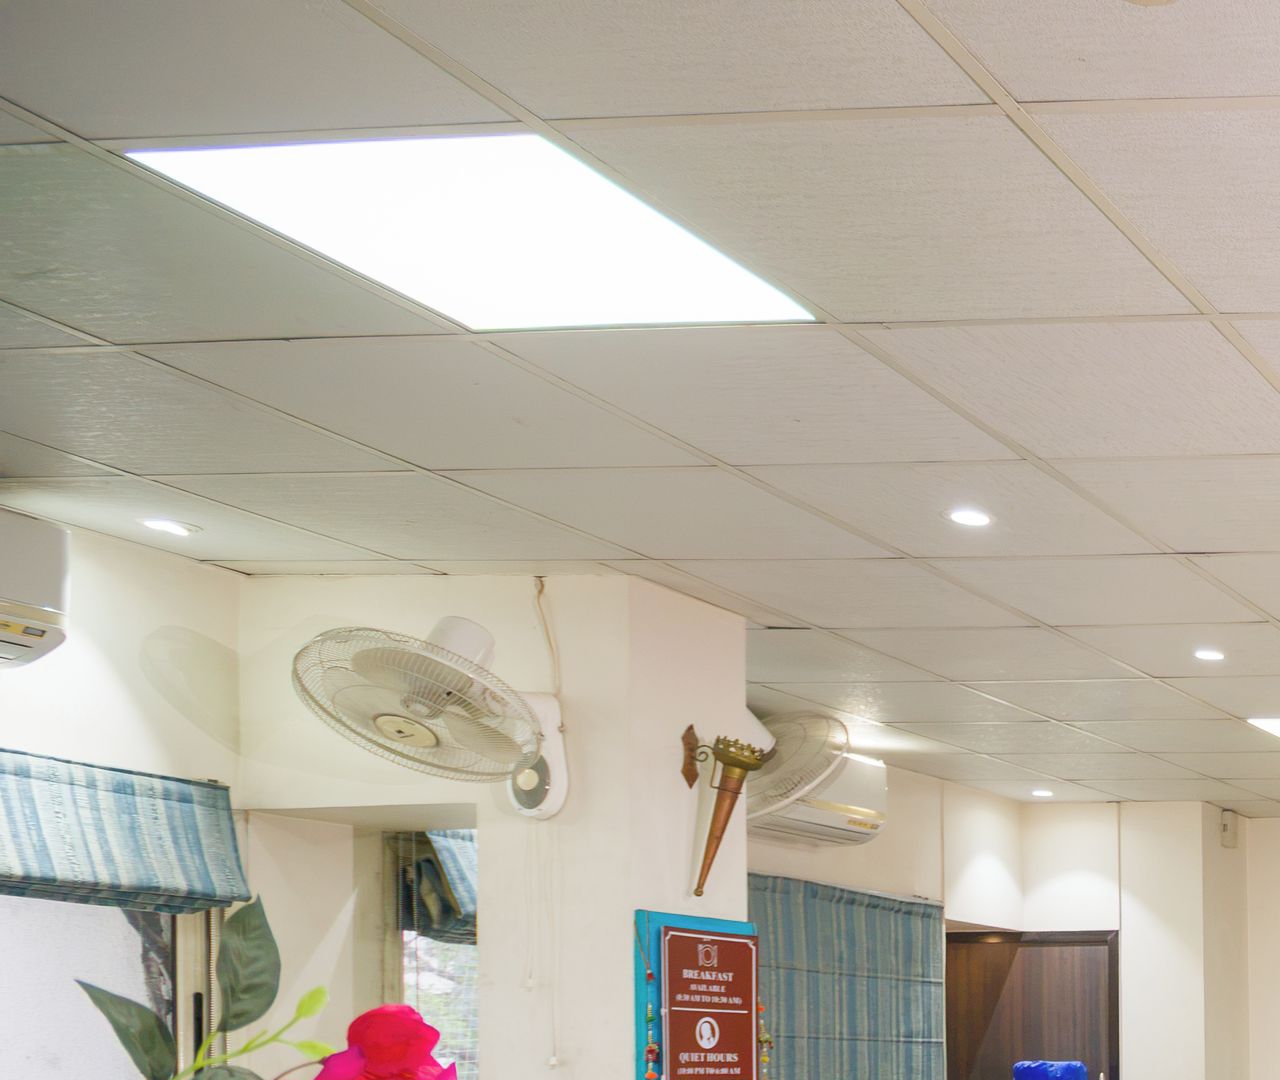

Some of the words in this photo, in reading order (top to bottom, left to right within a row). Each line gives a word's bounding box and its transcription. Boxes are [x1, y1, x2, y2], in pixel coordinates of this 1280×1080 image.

[682, 969, 734, 982] BREAKFAST
[679, 1053, 705, 1064] QUIET
[706, 1053, 738, 1062] HOURS
